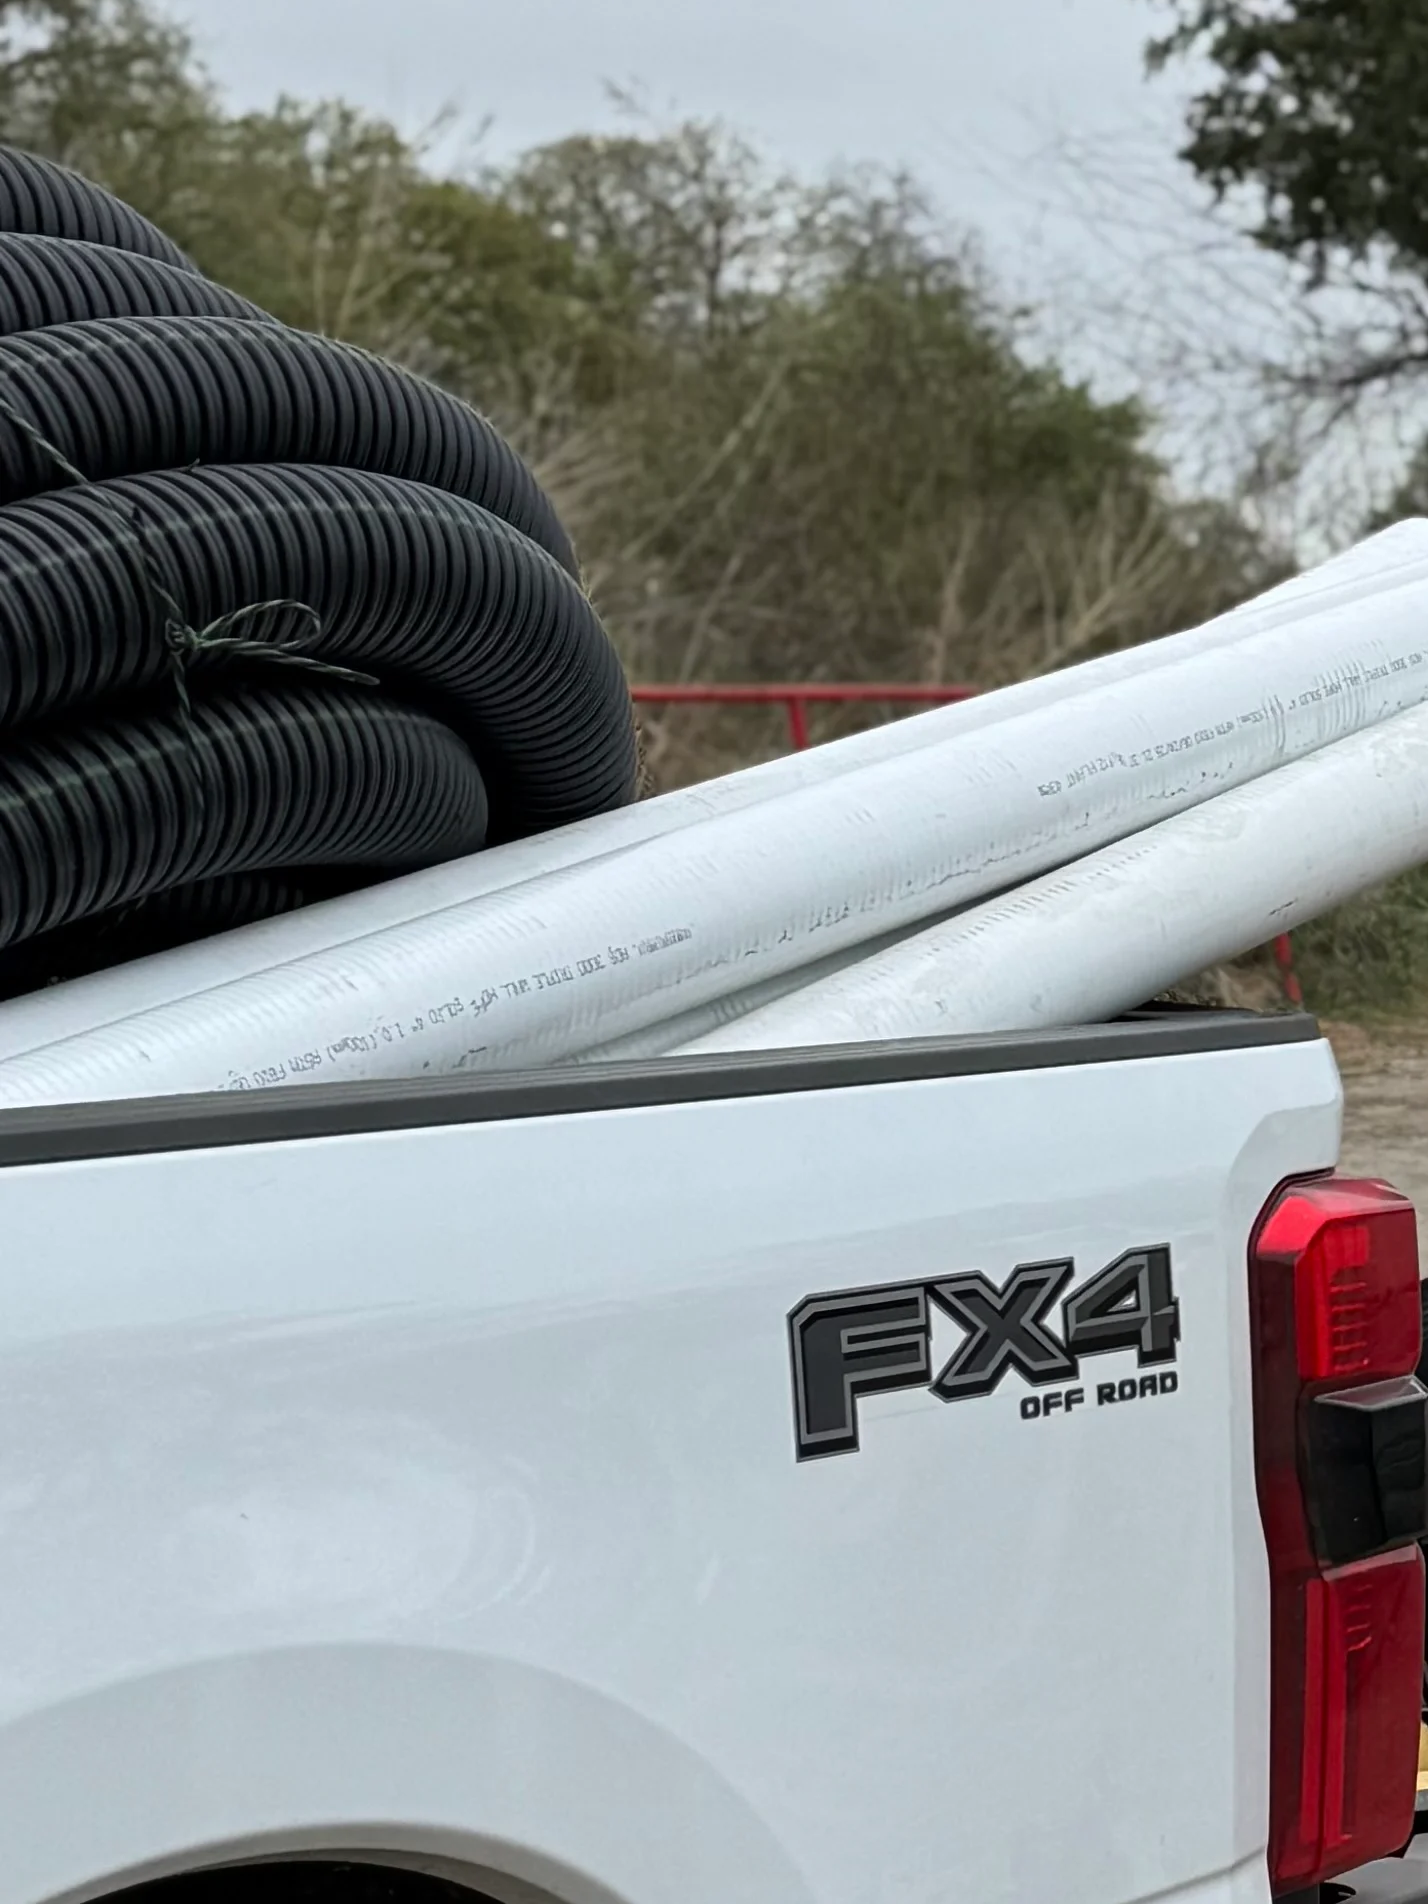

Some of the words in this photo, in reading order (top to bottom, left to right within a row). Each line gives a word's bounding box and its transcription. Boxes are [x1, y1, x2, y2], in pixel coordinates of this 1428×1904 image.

[787, 1242, 1181, 1463] FX4
[1020, 1387, 1085, 1421] OFF
[1098, 1370, 1178, 1409] ROAD
